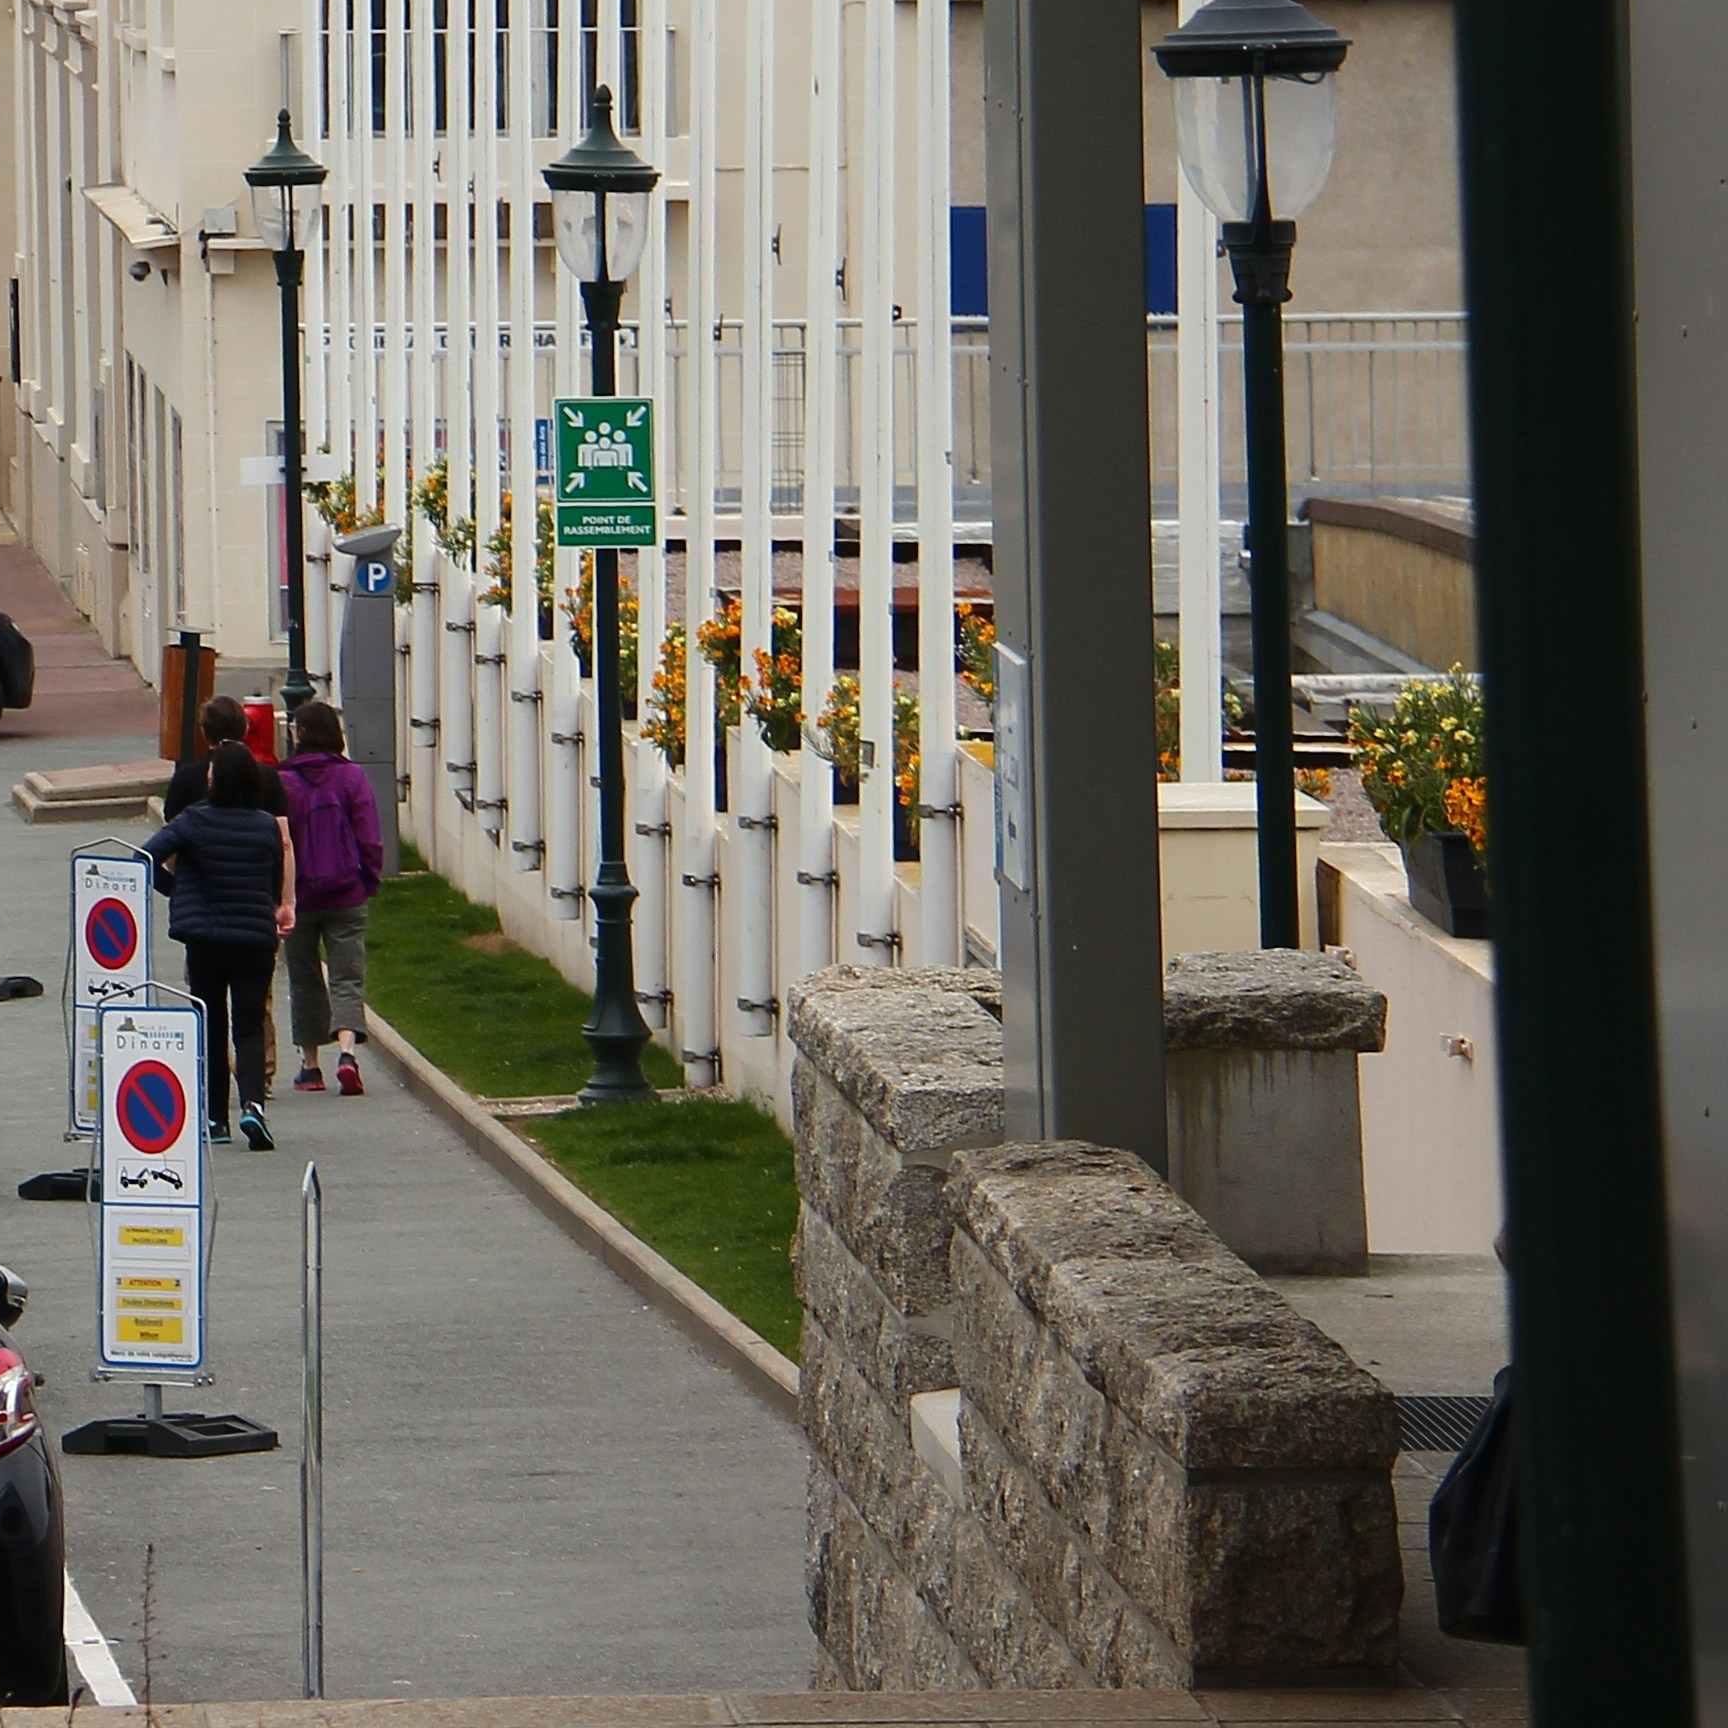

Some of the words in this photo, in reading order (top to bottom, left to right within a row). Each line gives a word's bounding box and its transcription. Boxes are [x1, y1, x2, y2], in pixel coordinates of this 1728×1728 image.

[582, 515, 614, 524] POINT
[617, 515, 631, 524] DE
[563, 526, 652, 535] RASSEMBLEMENT
[85, 878, 137, 892] Dinard
[116, 1033, 185, 1051] Dinard
